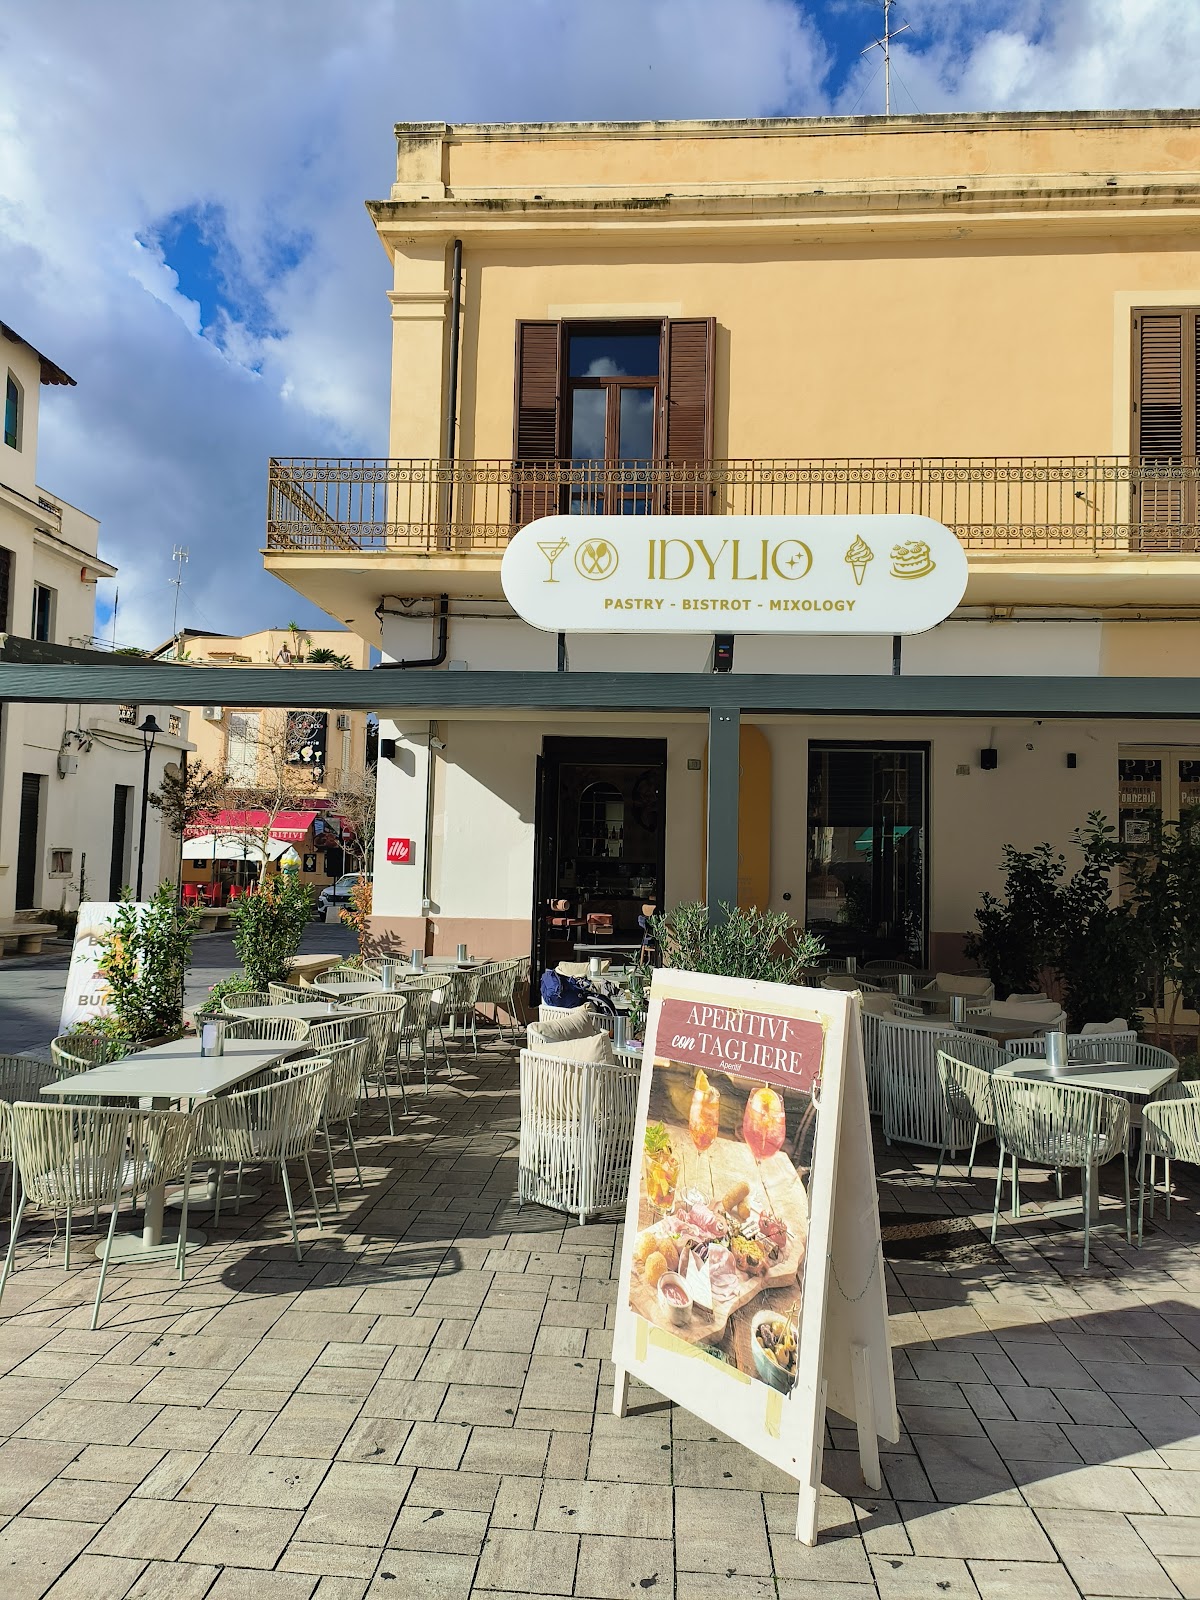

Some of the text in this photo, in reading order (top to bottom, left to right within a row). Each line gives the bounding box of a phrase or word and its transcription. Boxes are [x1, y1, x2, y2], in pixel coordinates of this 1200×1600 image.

[647, 539, 813, 580] IDYLIO
[604, 598, 665, 610] PASTRY
[682, 599, 752, 611] BISTROT
[769, 599, 856, 612] MIXOLOGY
[388, 841, 409, 860] illy
[686, 1005, 790, 1042] APERITIVI
[671, 1032, 803, 1075] con TAGLIERE
